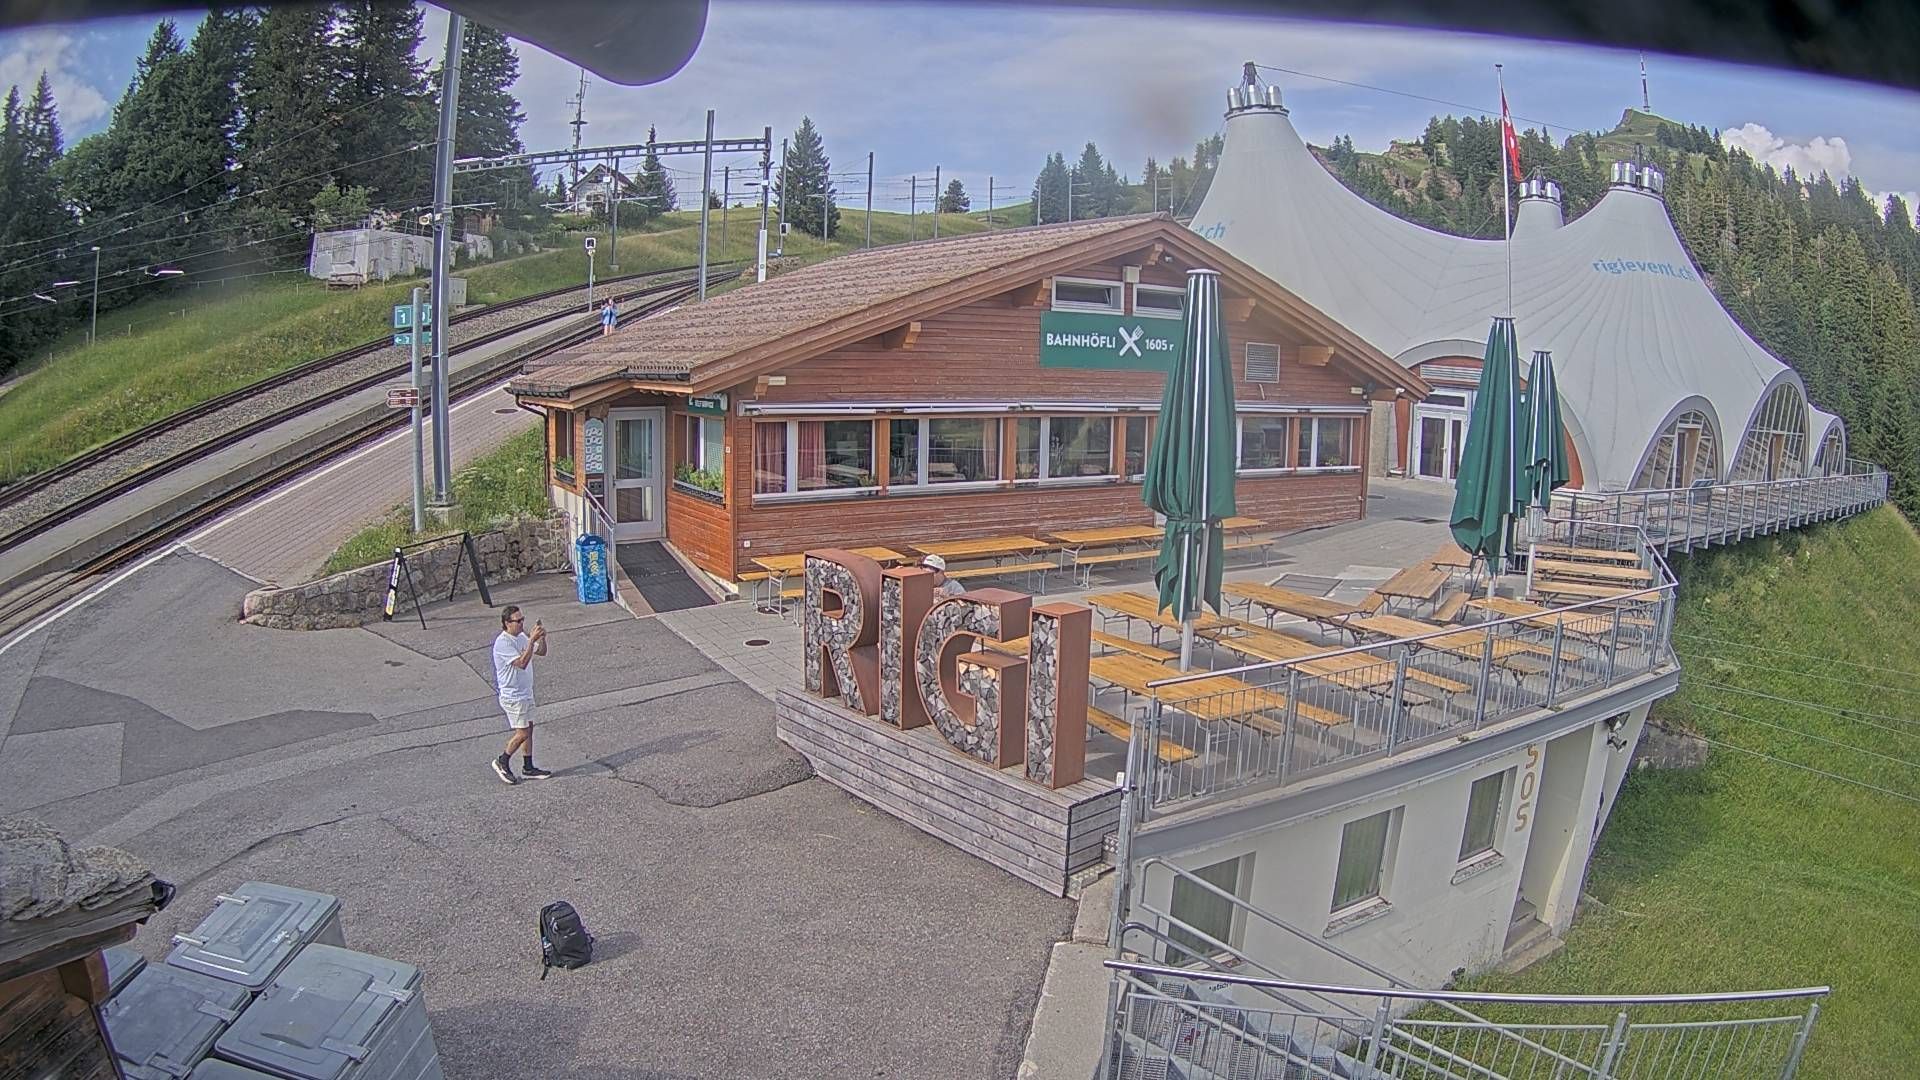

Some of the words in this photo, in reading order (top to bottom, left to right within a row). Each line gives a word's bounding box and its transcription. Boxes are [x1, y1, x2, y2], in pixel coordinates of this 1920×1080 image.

[1592, 258, 1696, 281] rigievent.ch
[400, 312, 406, 324] 1
[1045, 332, 1117, 349] BAHNHÖFLI
[1145, 338, 1168, 351] 1605
[803, 549, 1092, 790] RIGI
[1514, 743, 1538, 833] SOS
